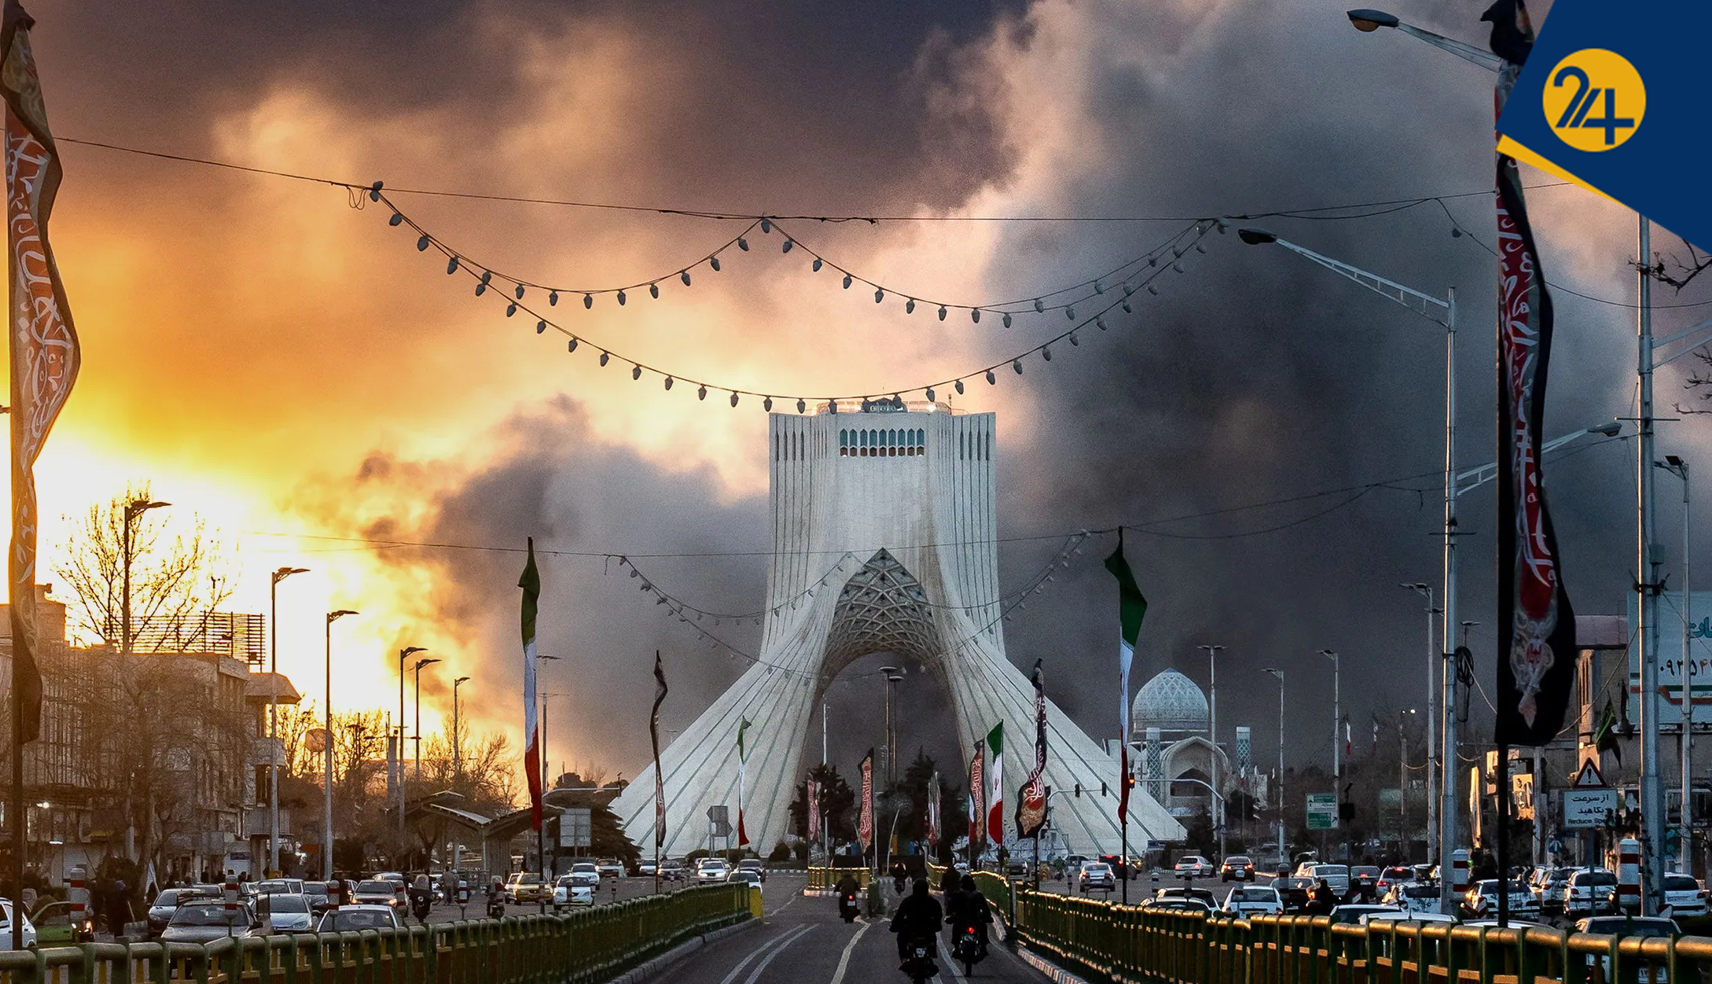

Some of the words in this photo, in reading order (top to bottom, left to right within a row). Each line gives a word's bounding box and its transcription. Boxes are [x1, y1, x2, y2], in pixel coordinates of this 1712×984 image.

[1571, 795, 1600, 804] سرعت
[1600, 793, 1609, 803] از
[1577, 806, 1605, 816] بکاهید
